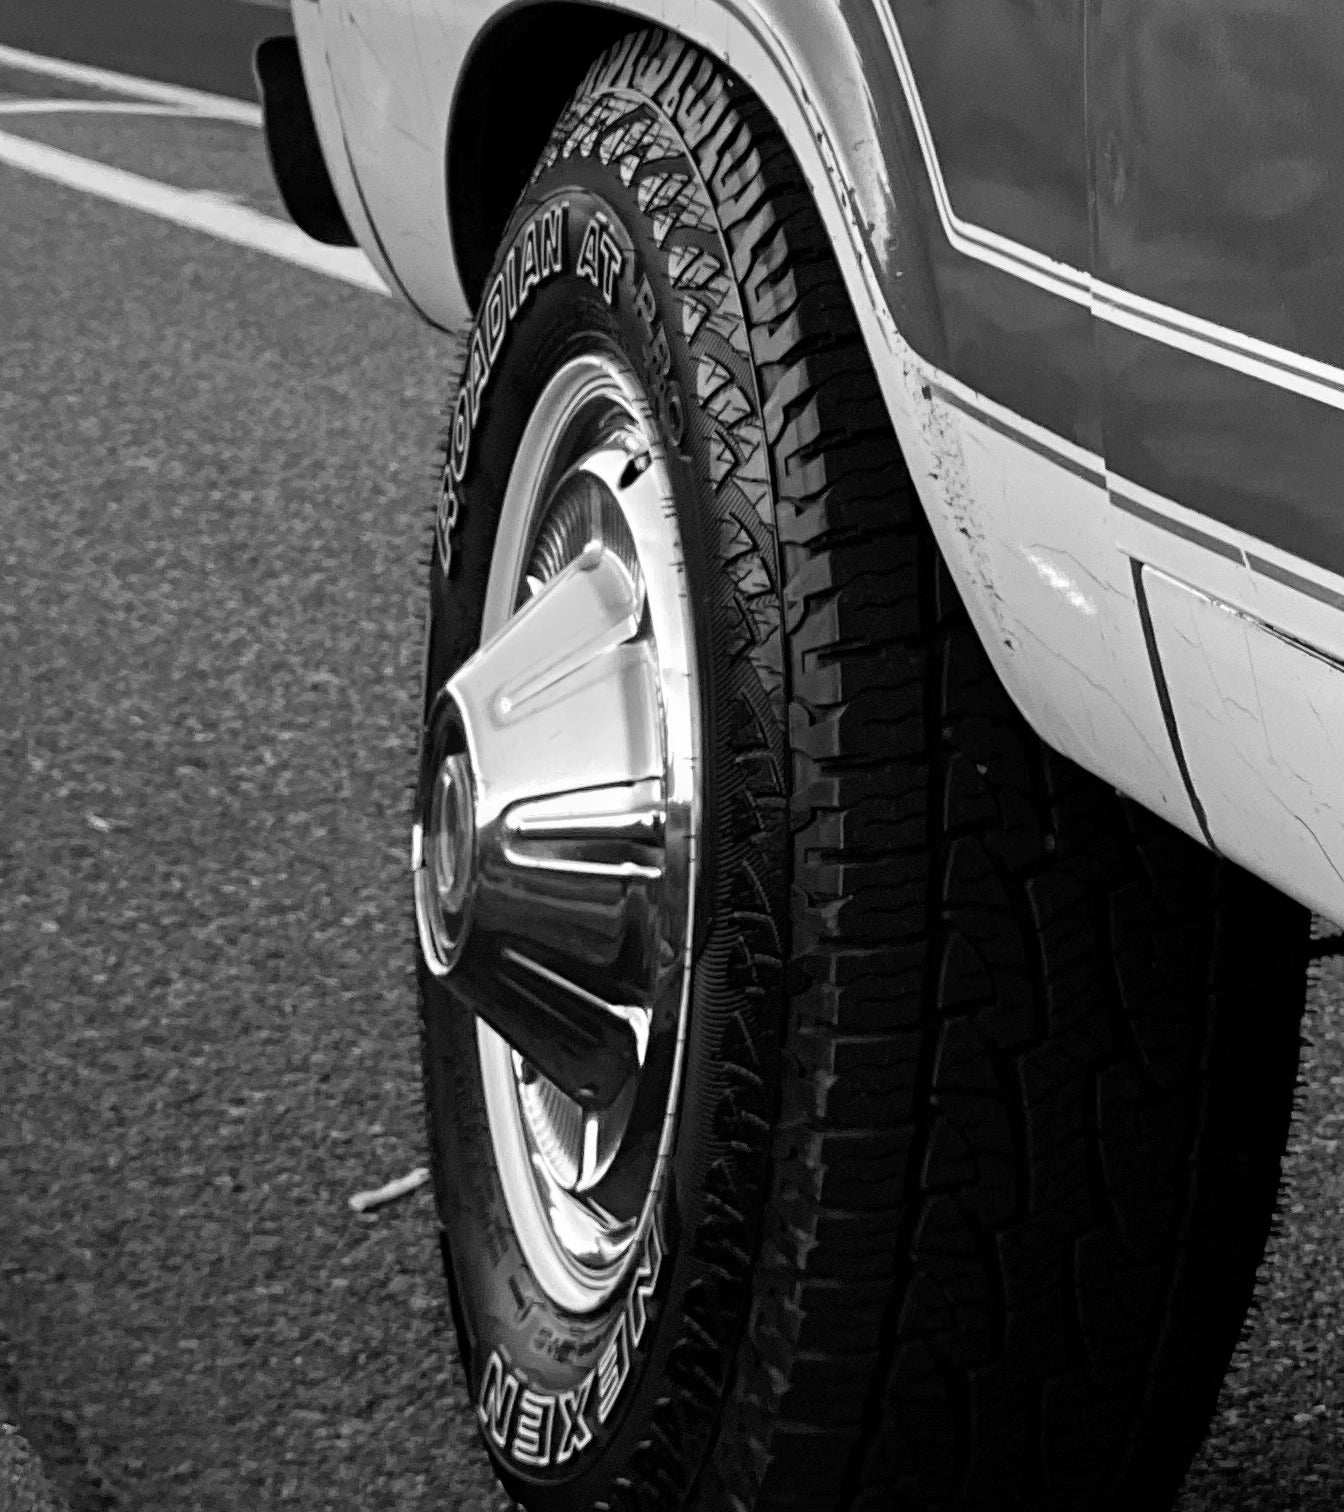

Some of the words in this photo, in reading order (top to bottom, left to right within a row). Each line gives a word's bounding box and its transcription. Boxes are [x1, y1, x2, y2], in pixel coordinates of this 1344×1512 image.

[437, 201, 569, 577] ROADIAN
[576, 217, 623, 305] AT
[478, 1210, 664, 1466] NEXEN
